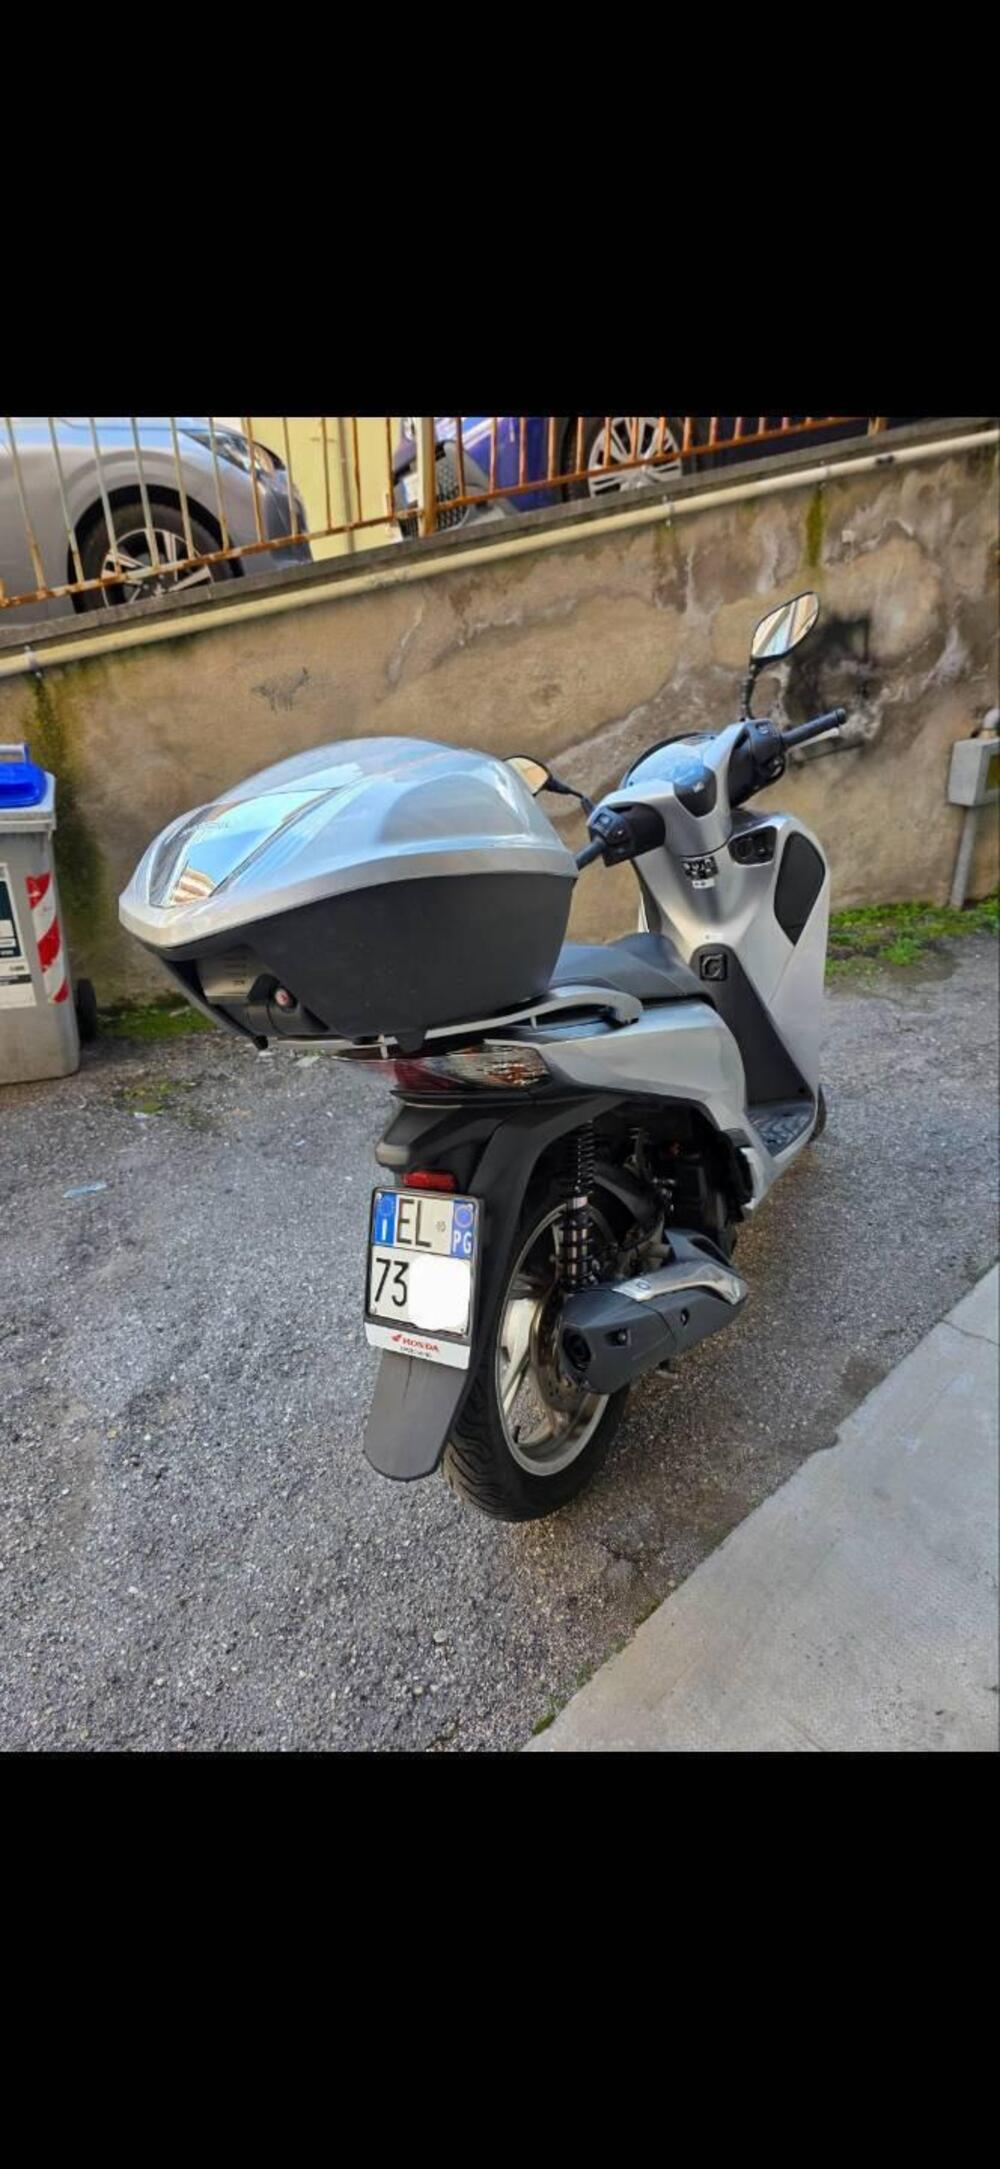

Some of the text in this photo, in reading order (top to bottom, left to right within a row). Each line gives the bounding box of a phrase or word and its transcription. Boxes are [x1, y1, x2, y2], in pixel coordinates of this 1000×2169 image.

[397, 1198, 431, 1247] EL
[453, 1230, 472, 1254] PG
[402, 1337, 439, 1352] HONDA
